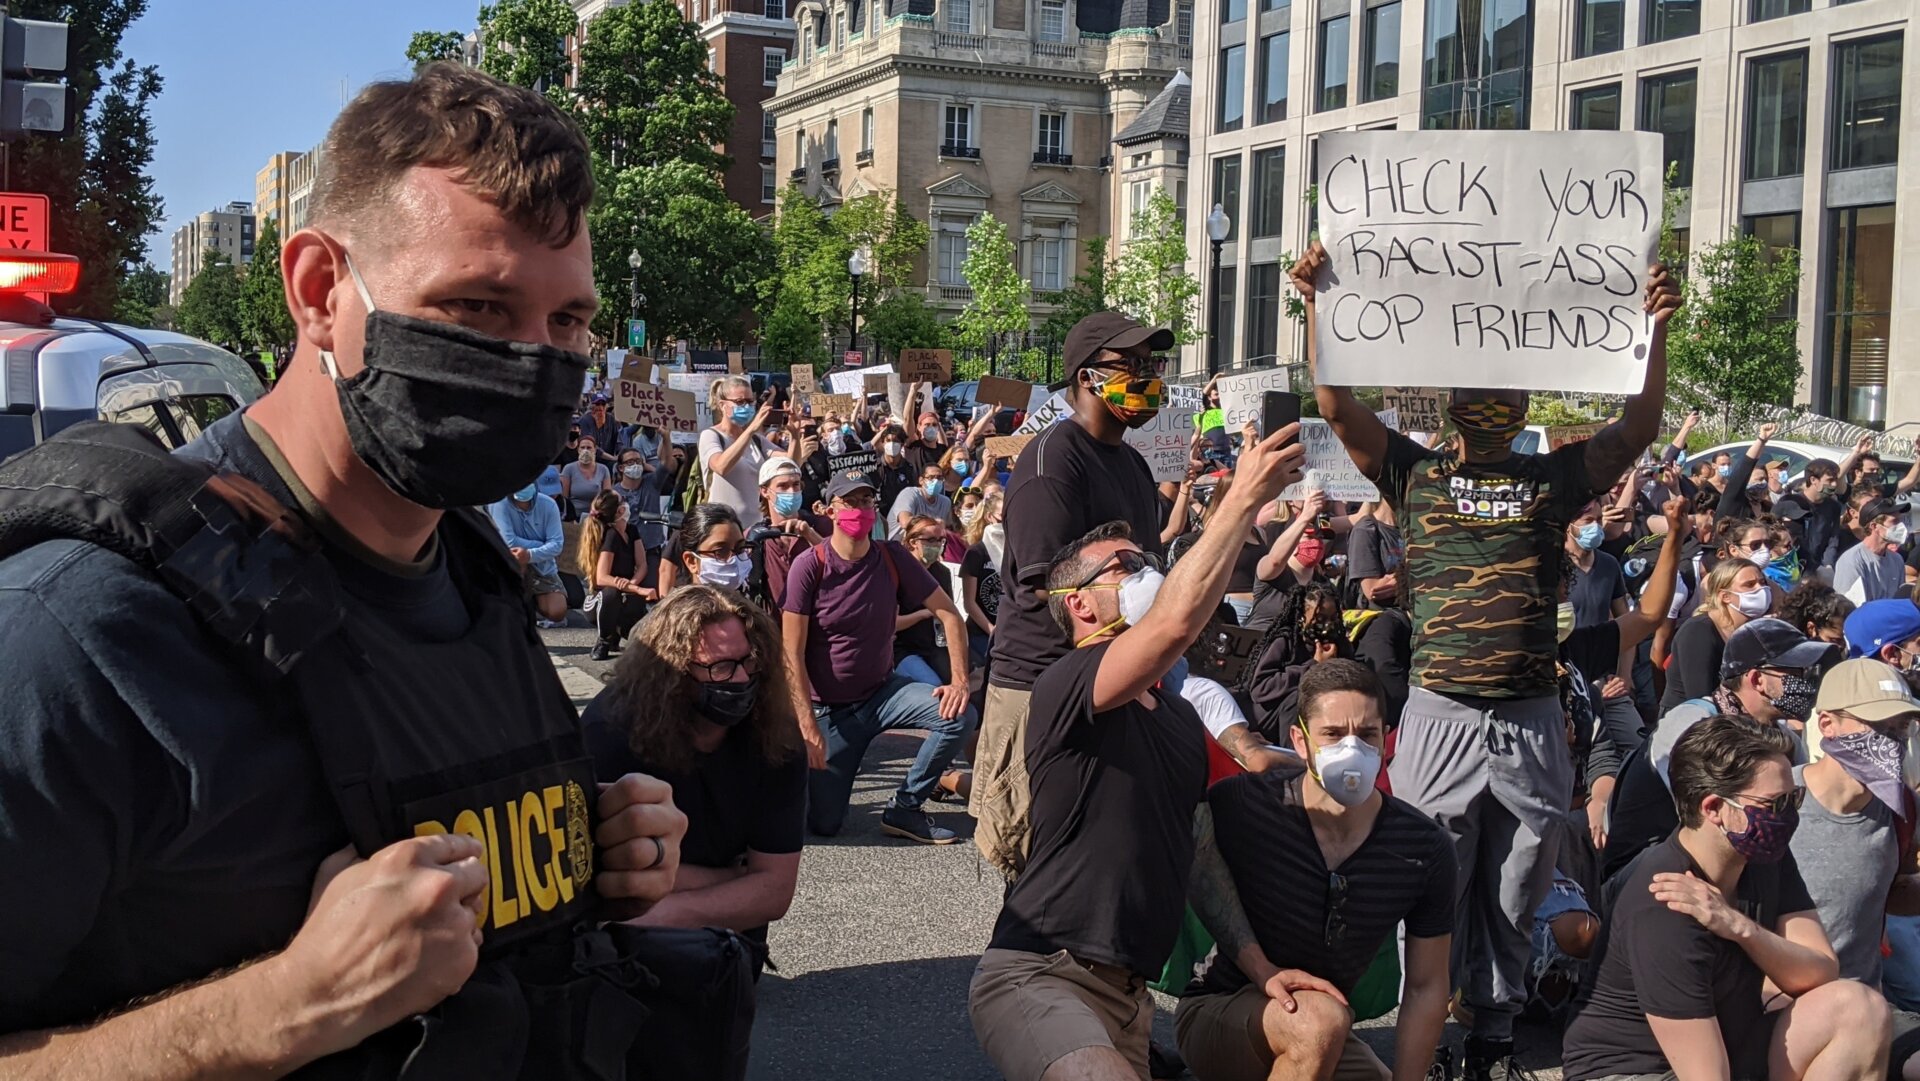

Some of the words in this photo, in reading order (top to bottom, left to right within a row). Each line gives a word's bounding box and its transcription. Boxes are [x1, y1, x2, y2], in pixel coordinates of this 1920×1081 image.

[1325, 155, 1497, 218] CHECK
[1540, 167, 1648, 242] YOUR
[1332, 294, 1424, 344] COP
[1452, 295, 1650, 360] FRIENDS!
[907, 352, 939, 361] BLACK
[621, 381, 665, 402] Black
[1221, 373, 1283, 394] JUSTICE
[631, 399, 676, 415] Lives
[1386, 397, 1438, 414] THEIR
[636, 411, 697, 431] Matter
[1132, 413, 1191, 433] OLICE
[1398, 415, 1439, 431] AMES
[1154, 434, 1189, 447] REAL
[830, 454, 877, 470] SYSTEMATIC
[1153, 451, 1186, 460] #BLACK
[1162, 457, 1184, 466] LIVES
[1157, 465, 1187, 474] MATTER
[1305, 459, 1337, 470] WHITE
[1313, 472, 1350, 482] PUBLIC
[1449, 488, 1502, 500] WOMEN
[1457, 499, 1522, 518] DOPE
